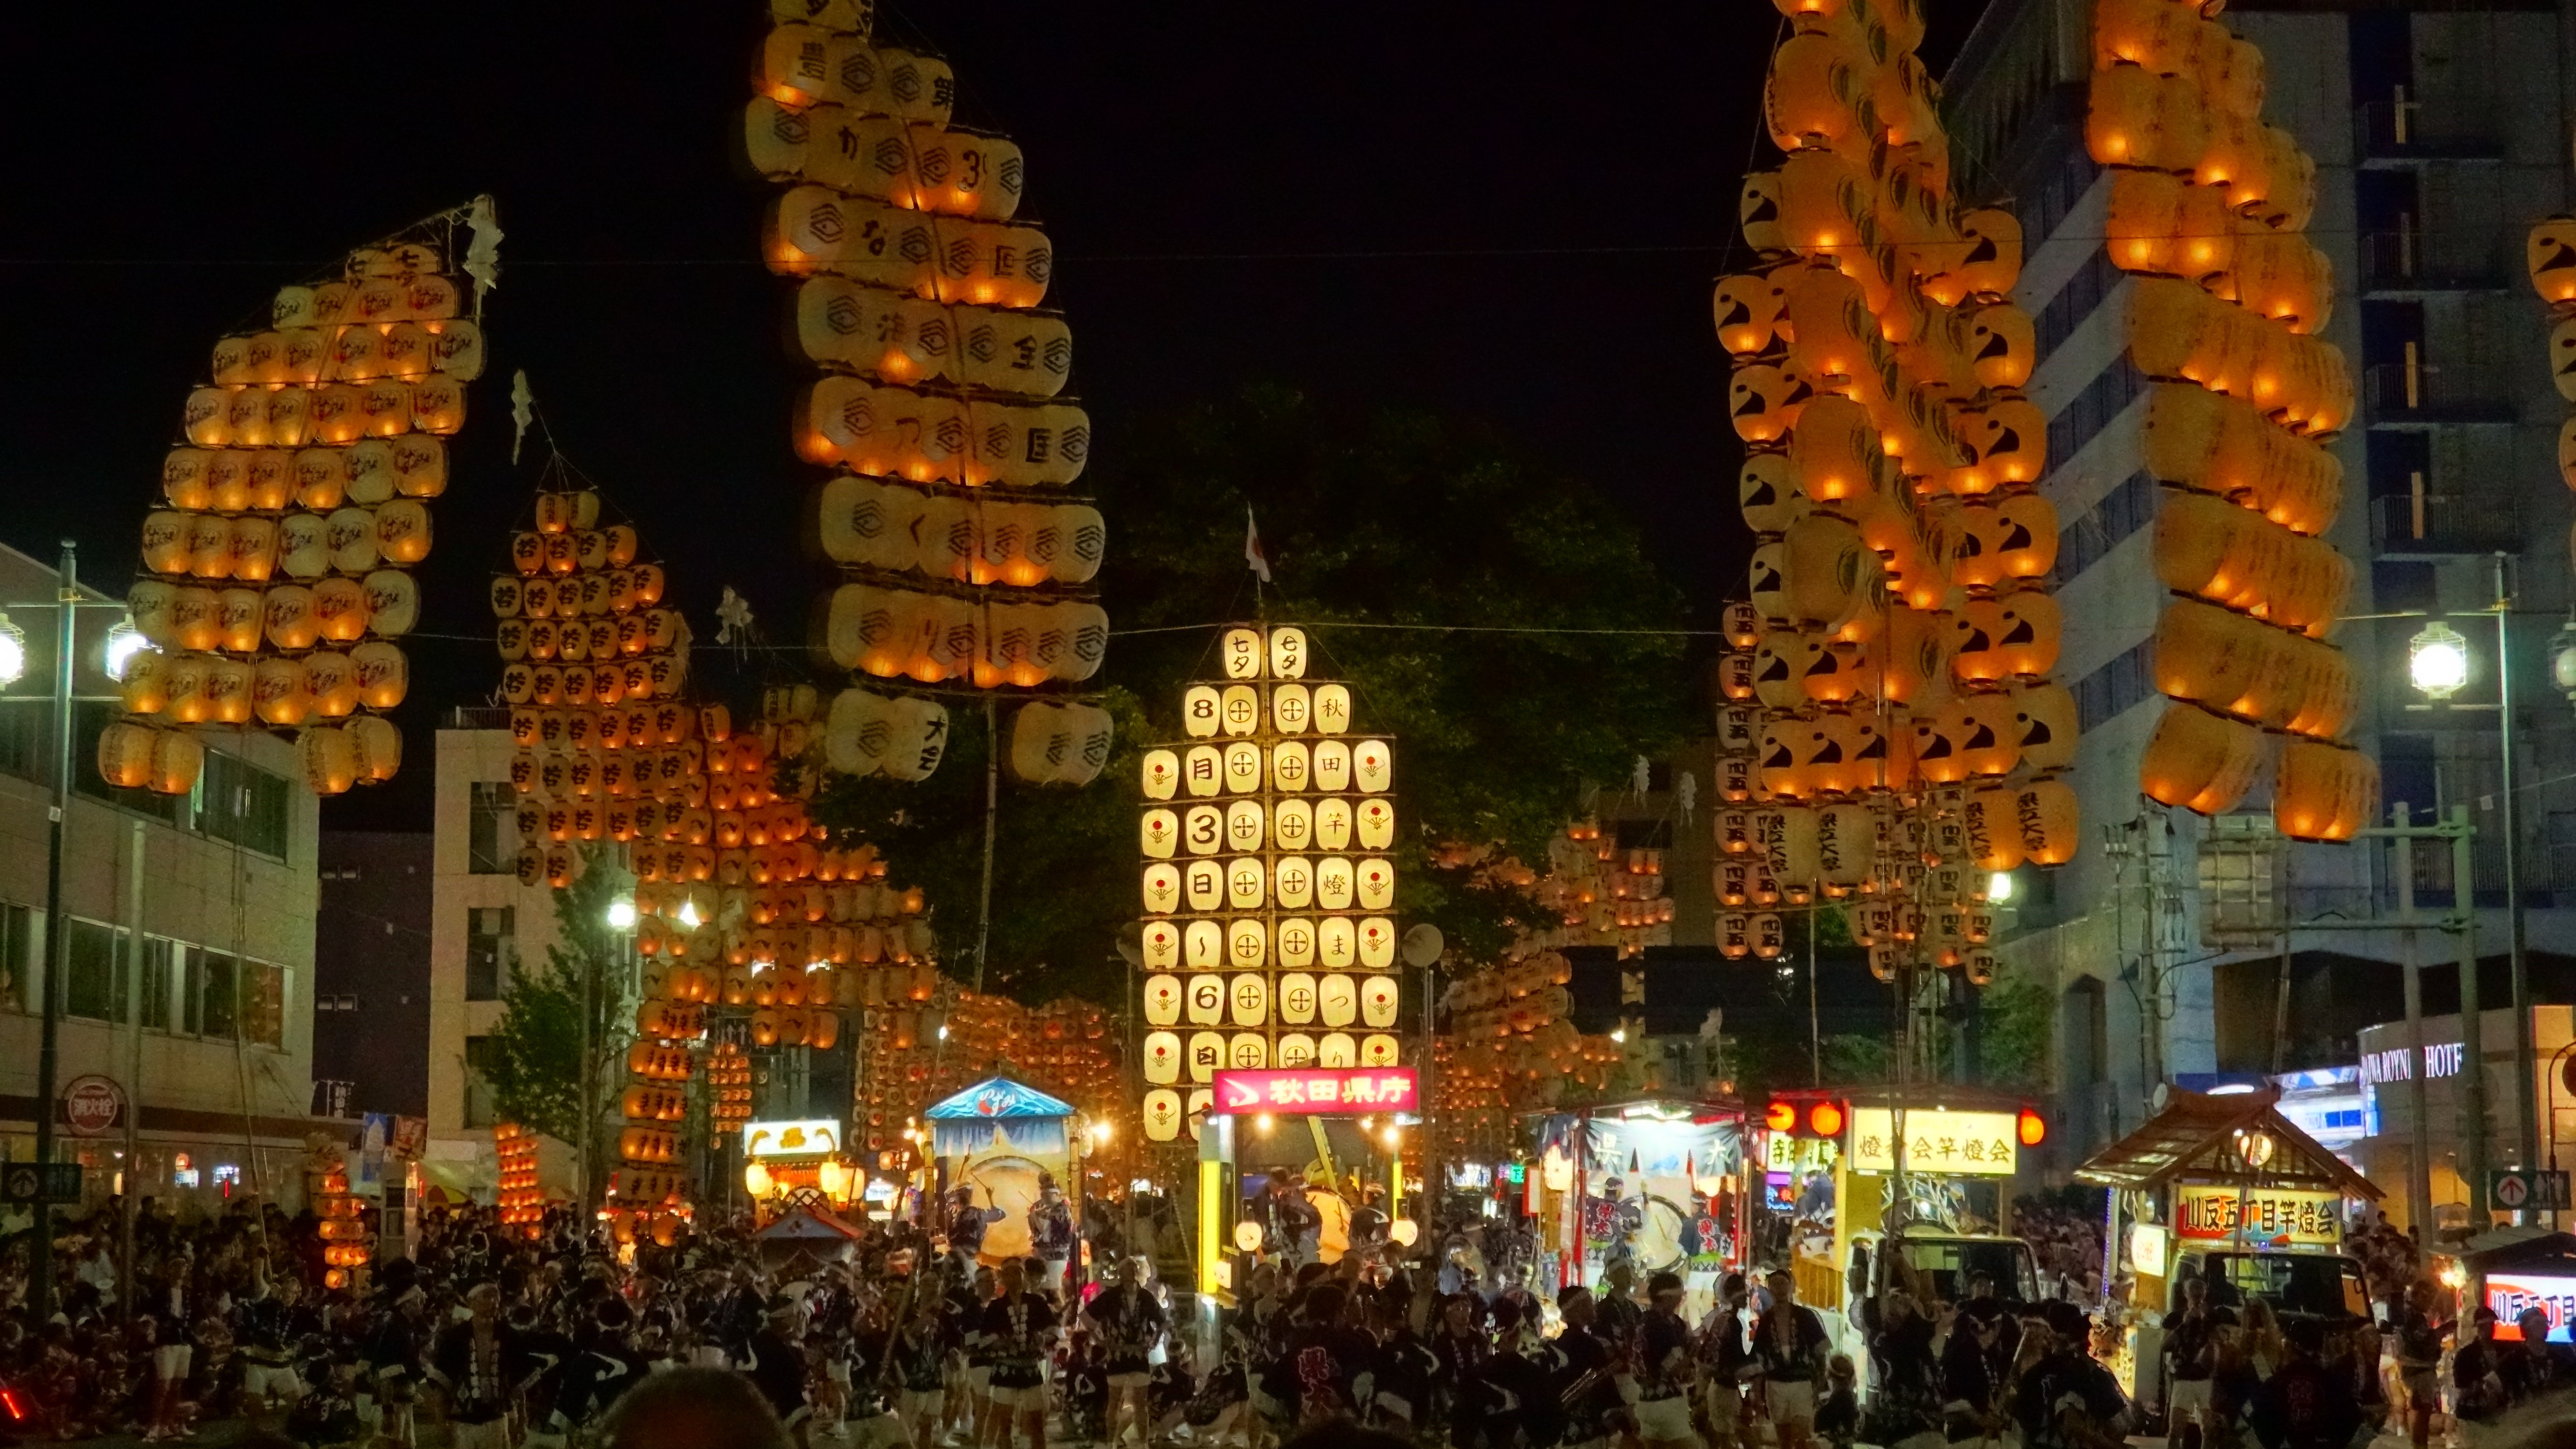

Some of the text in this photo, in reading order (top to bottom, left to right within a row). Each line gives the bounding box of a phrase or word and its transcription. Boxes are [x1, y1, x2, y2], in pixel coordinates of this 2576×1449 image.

[1231, 635, 1251, 673] 七夕
[1281, 635, 1299, 672] 七夕
[2382, 1048, 2411, 1082] ROYN
[2424, 1042, 2464, 1078] HOTE
[74, 1097, 113, 1116] 消火栓
[979, 1089, 1016, 1117] いずみ
[1270, 1076, 1411, 1105] 秋田県庁
[1859, 1135, 2011, 1164] 燈会竿燈会
[2184, 1196, 2334, 1235] 川反五丁目竿燈会
